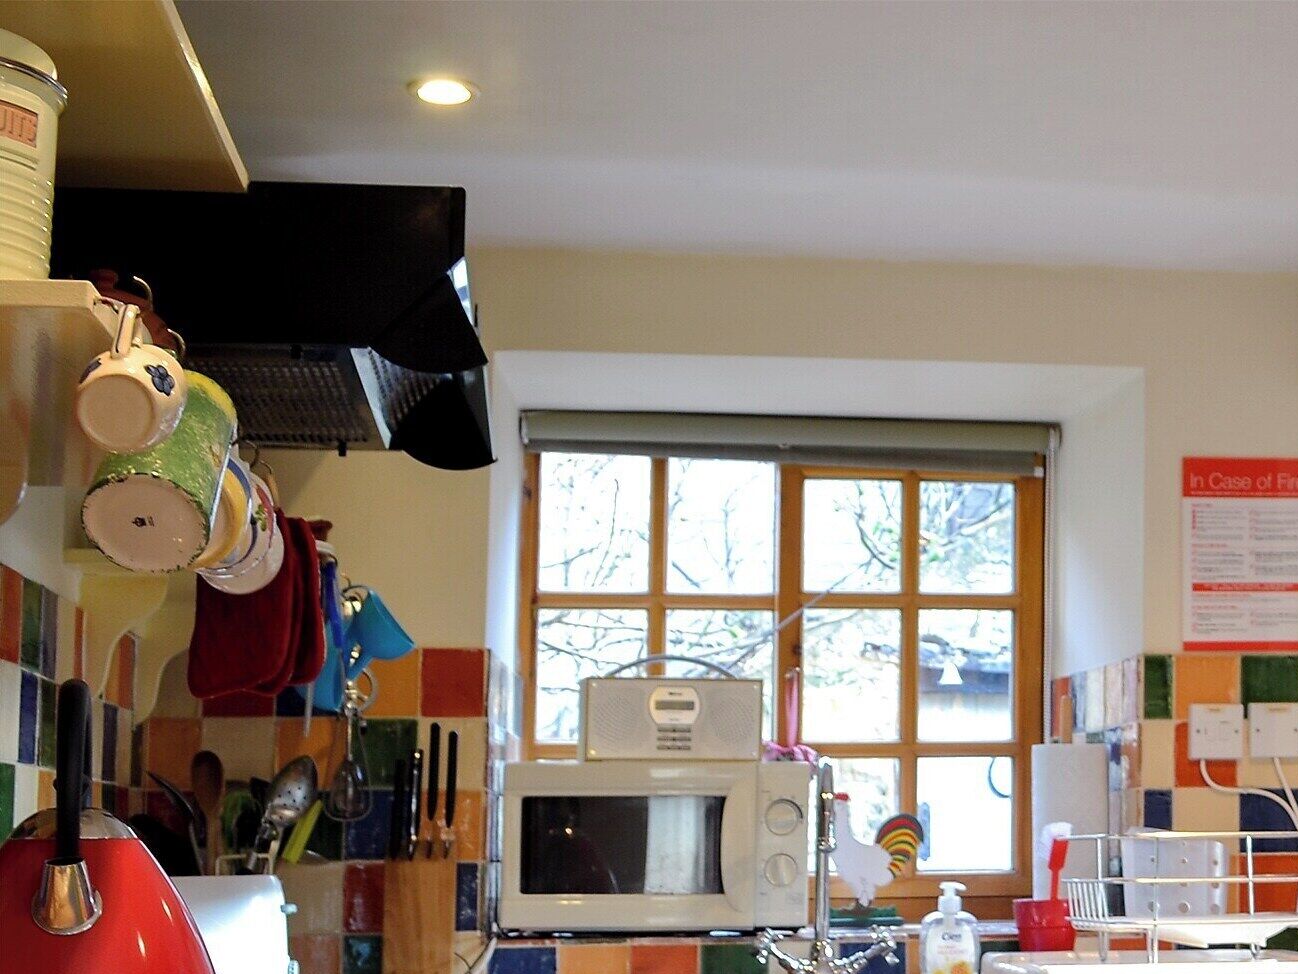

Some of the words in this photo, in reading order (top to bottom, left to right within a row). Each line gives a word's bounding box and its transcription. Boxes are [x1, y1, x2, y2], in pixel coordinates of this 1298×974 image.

[1189, 472, 1204, 489] In
[1208, 471, 1252, 490] Case
[1256, 472, 1272, 490] of
